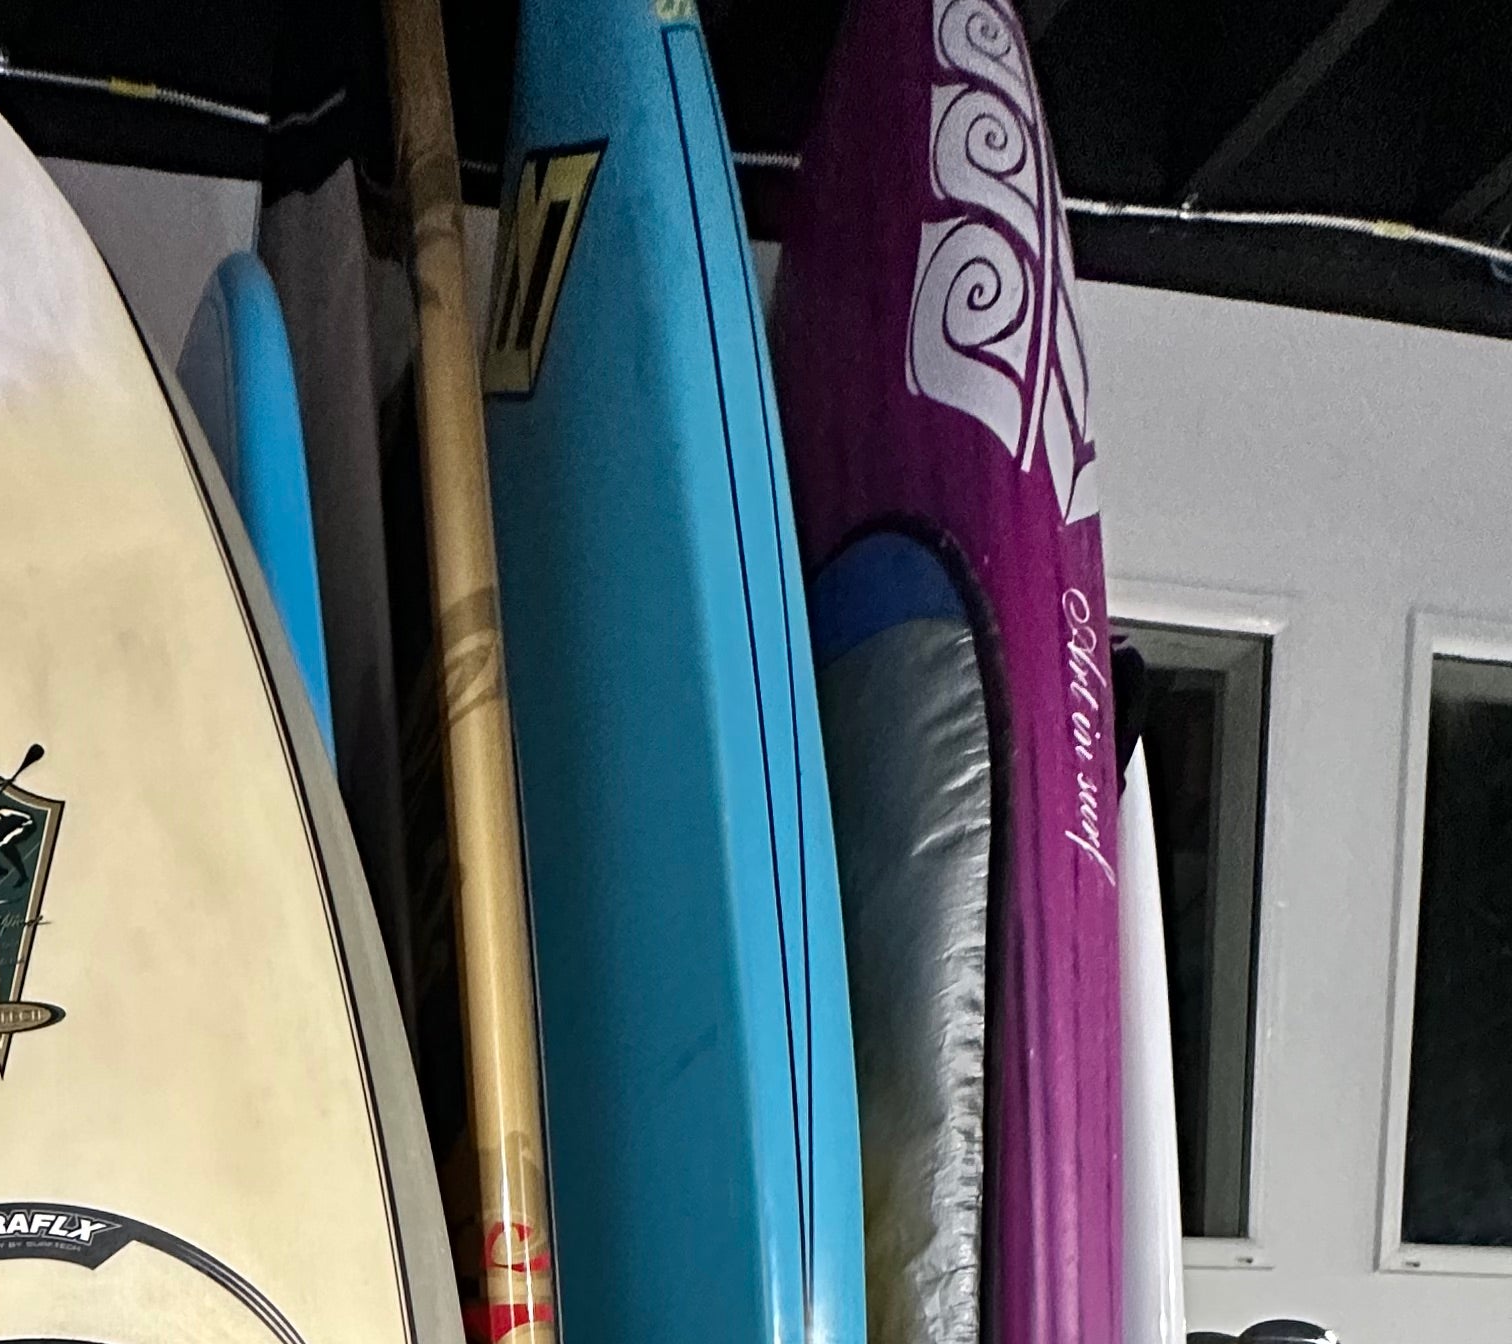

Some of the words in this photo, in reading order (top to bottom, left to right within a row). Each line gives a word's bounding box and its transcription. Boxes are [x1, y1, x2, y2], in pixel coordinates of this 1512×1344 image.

[1072, 712, 1101, 760] in
[1065, 772, 1116, 886] surf
[8, 1241, 23, 1249] BY
